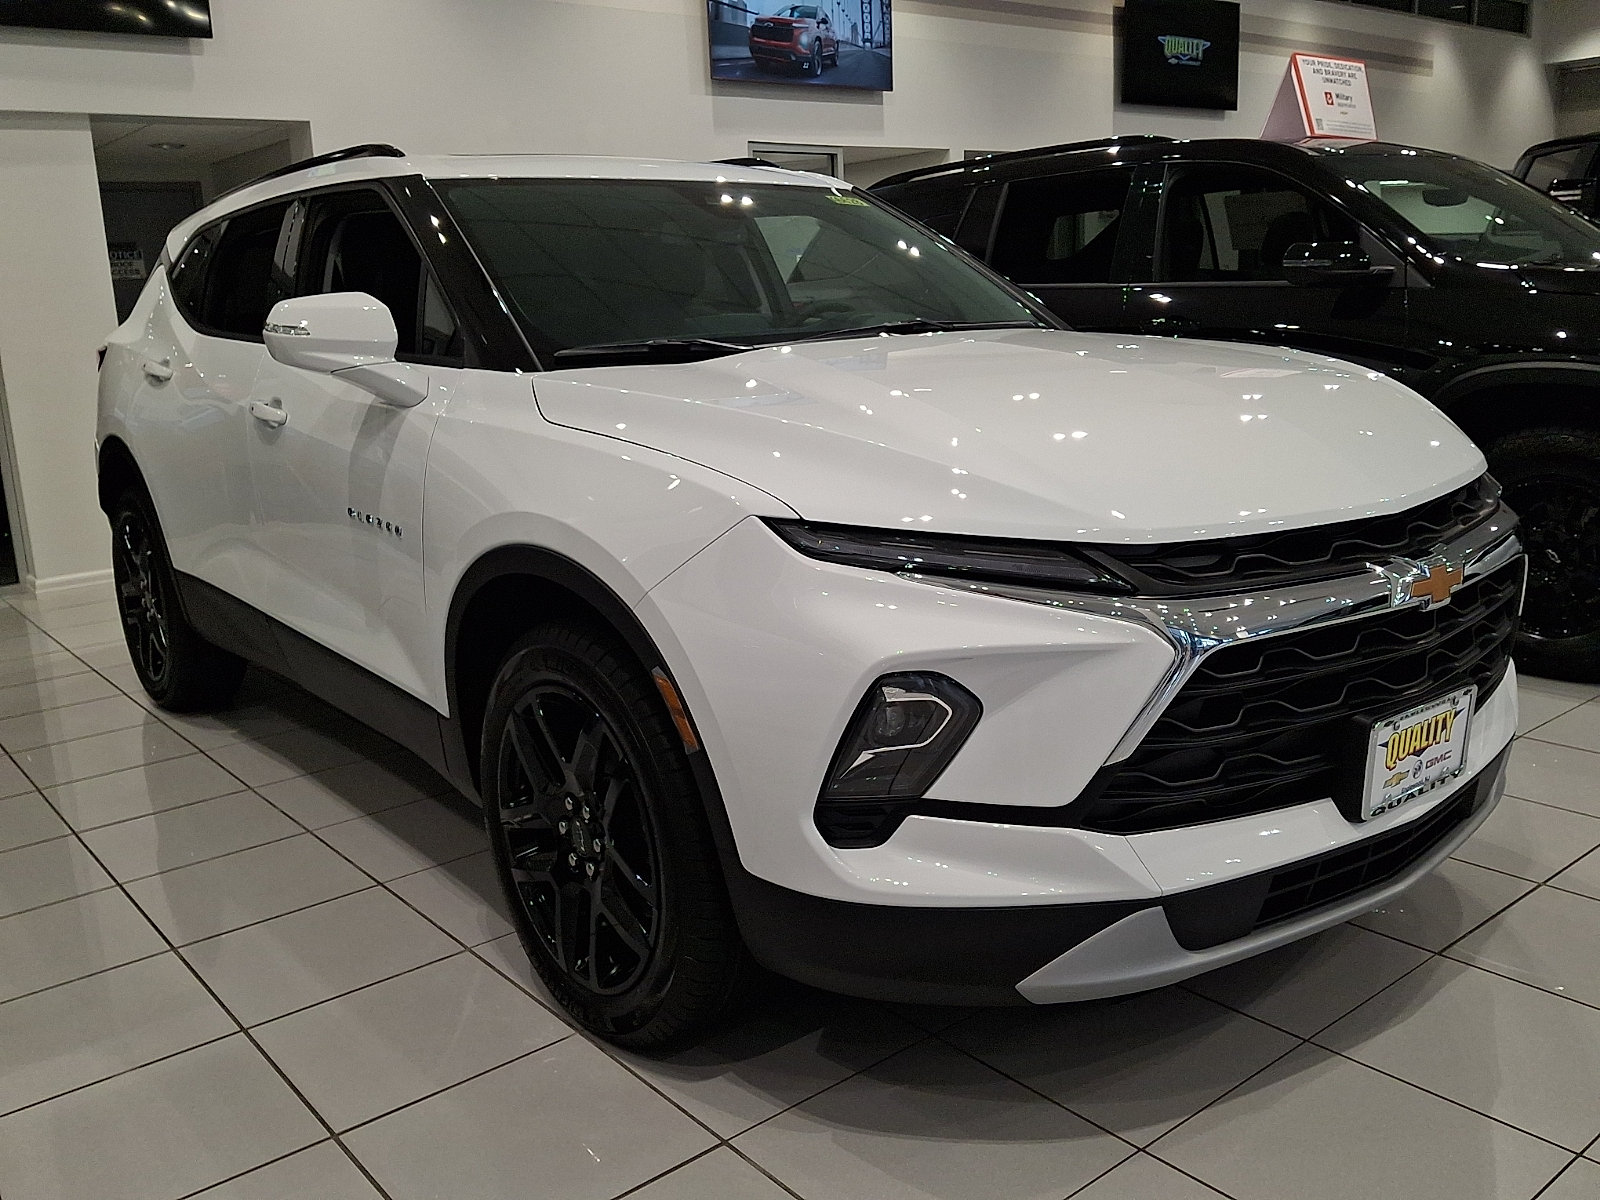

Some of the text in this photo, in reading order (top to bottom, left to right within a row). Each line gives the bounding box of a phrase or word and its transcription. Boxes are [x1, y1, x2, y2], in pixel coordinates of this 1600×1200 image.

[1164, 35, 1204, 60] QUALITY
[1302, 59, 1317, 67] YOUR
[1335, 92, 1353, 103] Military
[347, 507, 403, 537] BLAZER
[1385, 709, 1457, 771] QUALITY
[1425, 750, 1453, 769] GMC
[1370, 770, 1460, 816] QUALITY
